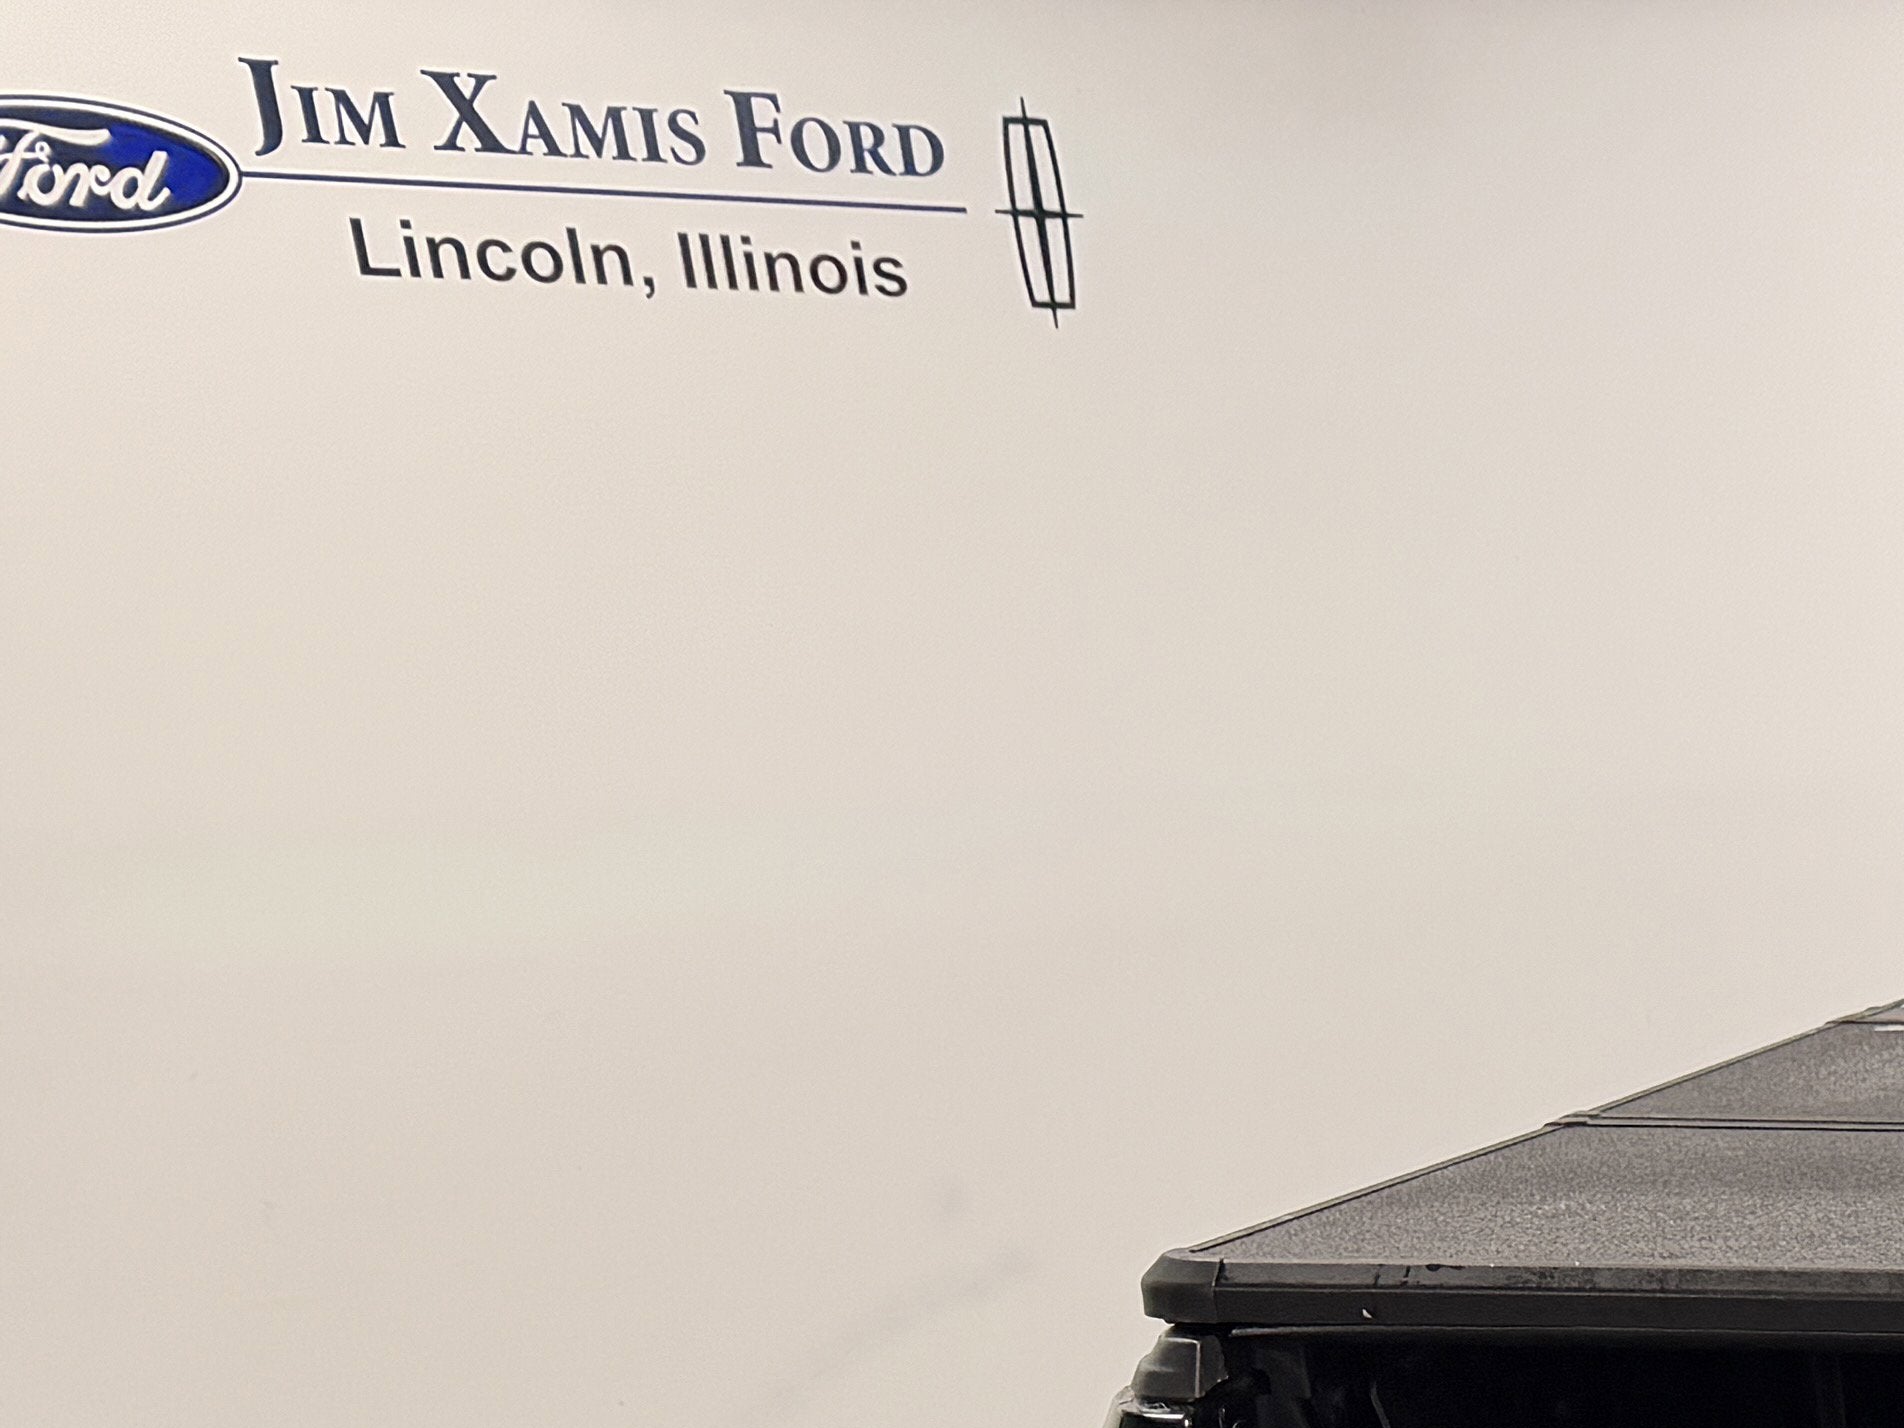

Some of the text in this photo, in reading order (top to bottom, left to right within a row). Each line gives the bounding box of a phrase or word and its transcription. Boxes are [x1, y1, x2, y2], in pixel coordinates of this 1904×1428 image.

[237, 55, 947, 178] JIM XAMIS FORD
[348, 216, 909, 300] Lincoln, Illinois
